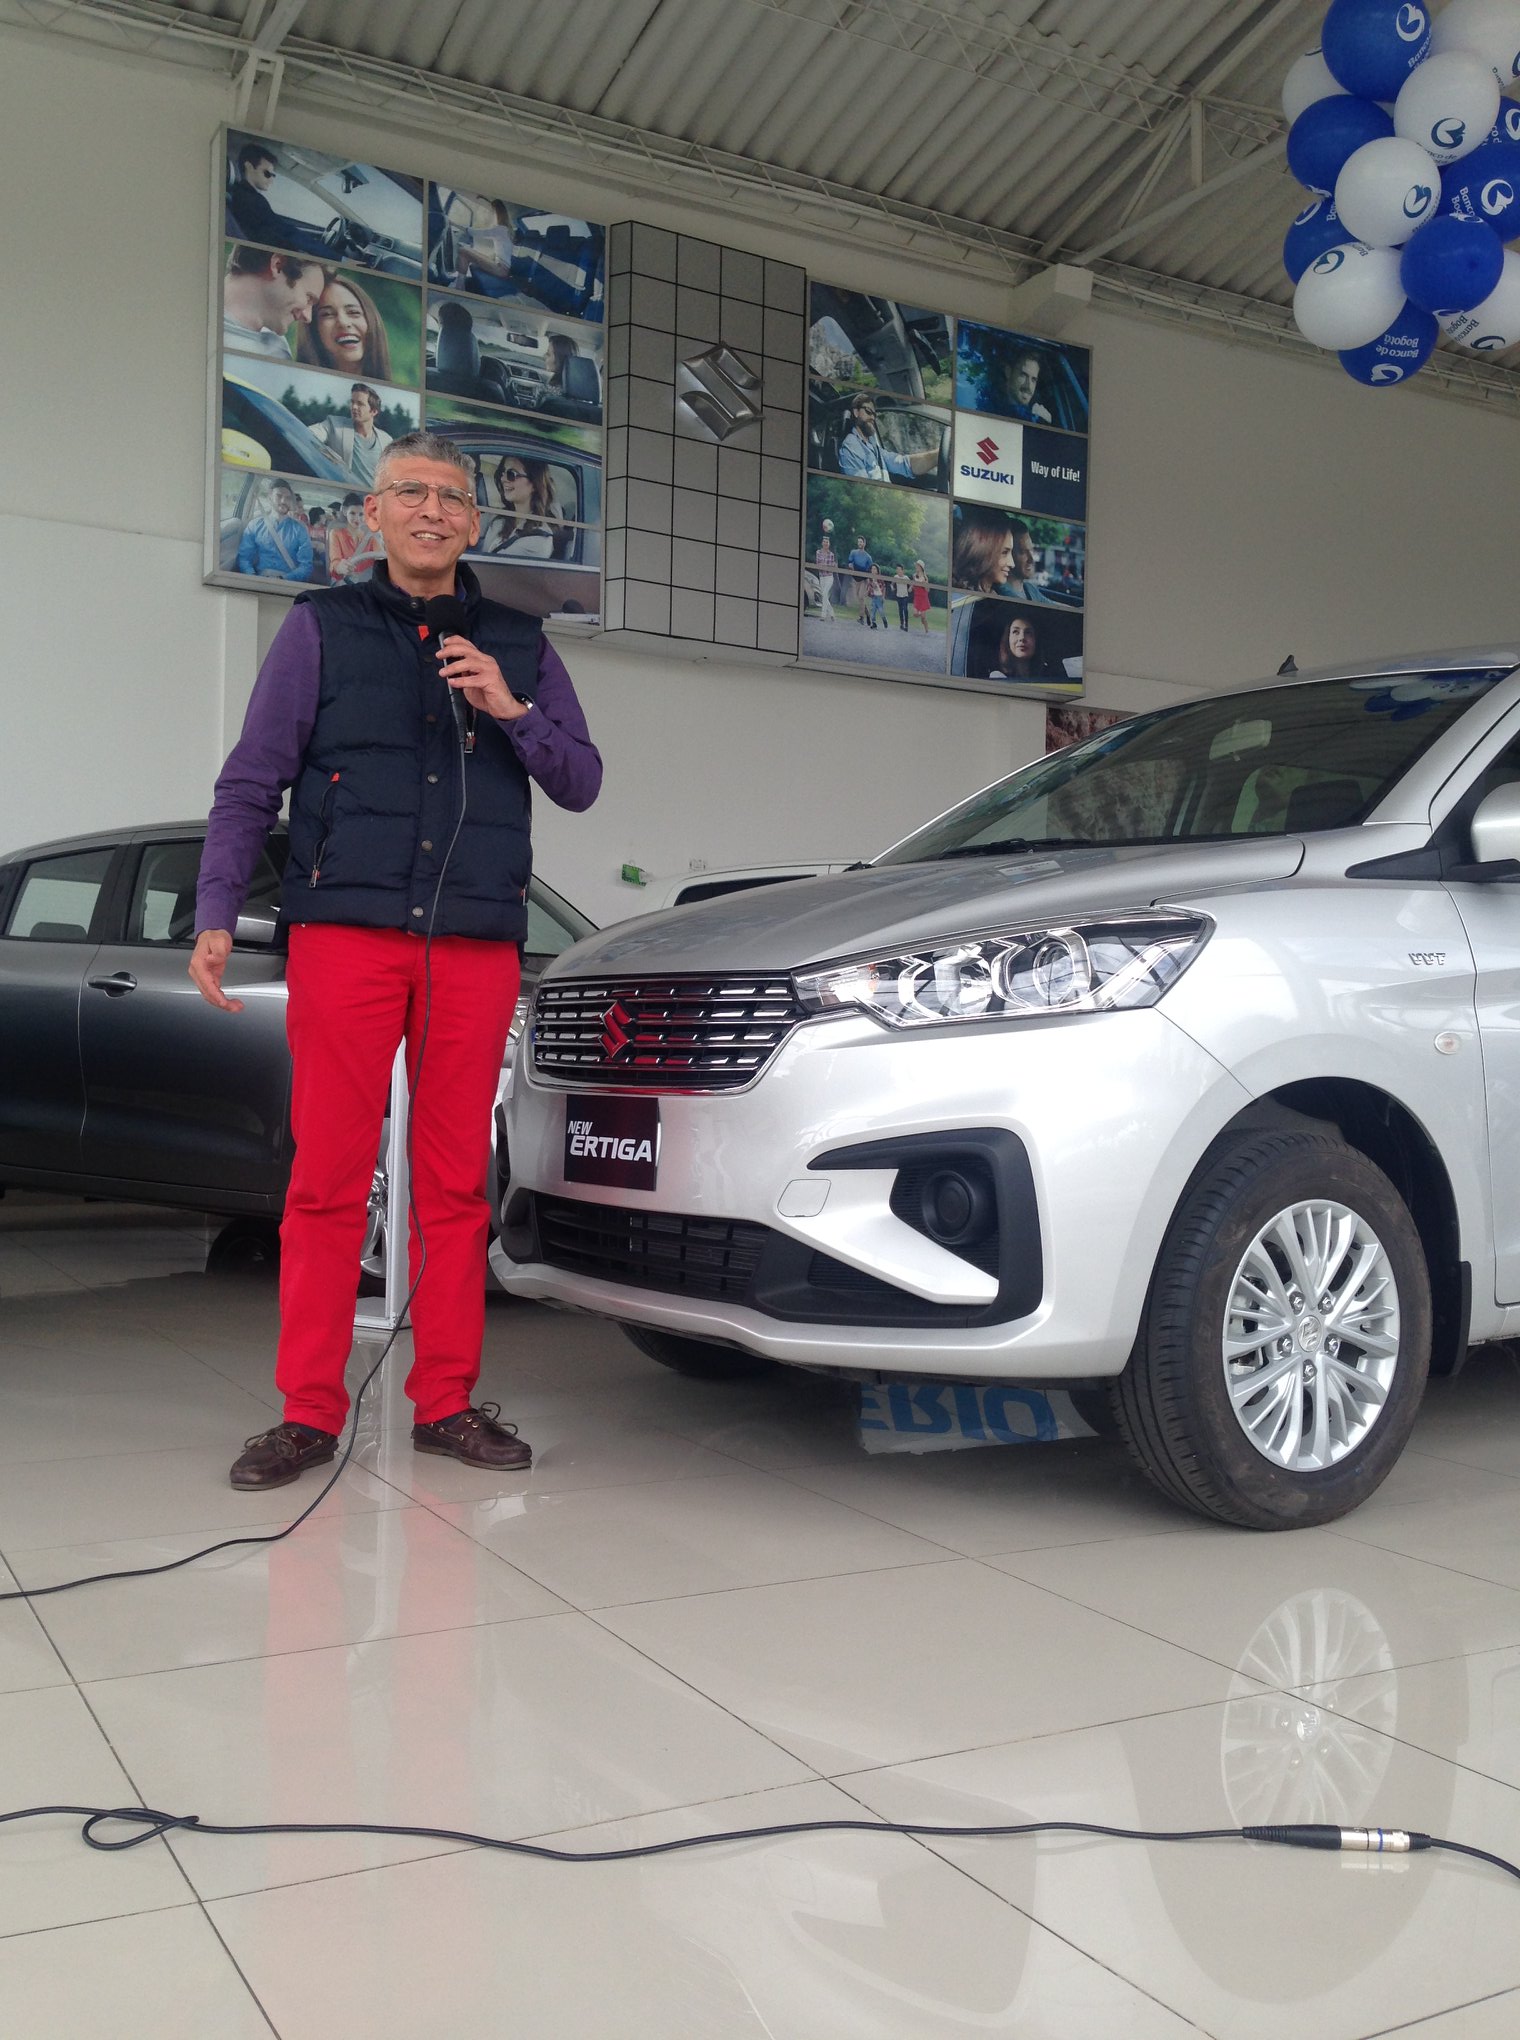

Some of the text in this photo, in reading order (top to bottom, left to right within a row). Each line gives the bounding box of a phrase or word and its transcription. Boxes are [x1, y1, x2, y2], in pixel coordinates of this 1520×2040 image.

[1459, 186, 1476, 216] Banco
[1375, 344, 1419, 358] Banco de
[1383, 334, 1419, 348] Bogotá
[960, 464, 1015, 485] SUZUKI
[1031, 460, 1080, 482] Way of Life!
[567, 1120, 593, 1135] NEW
[569, 1134, 652, 1163] ERTIGA
